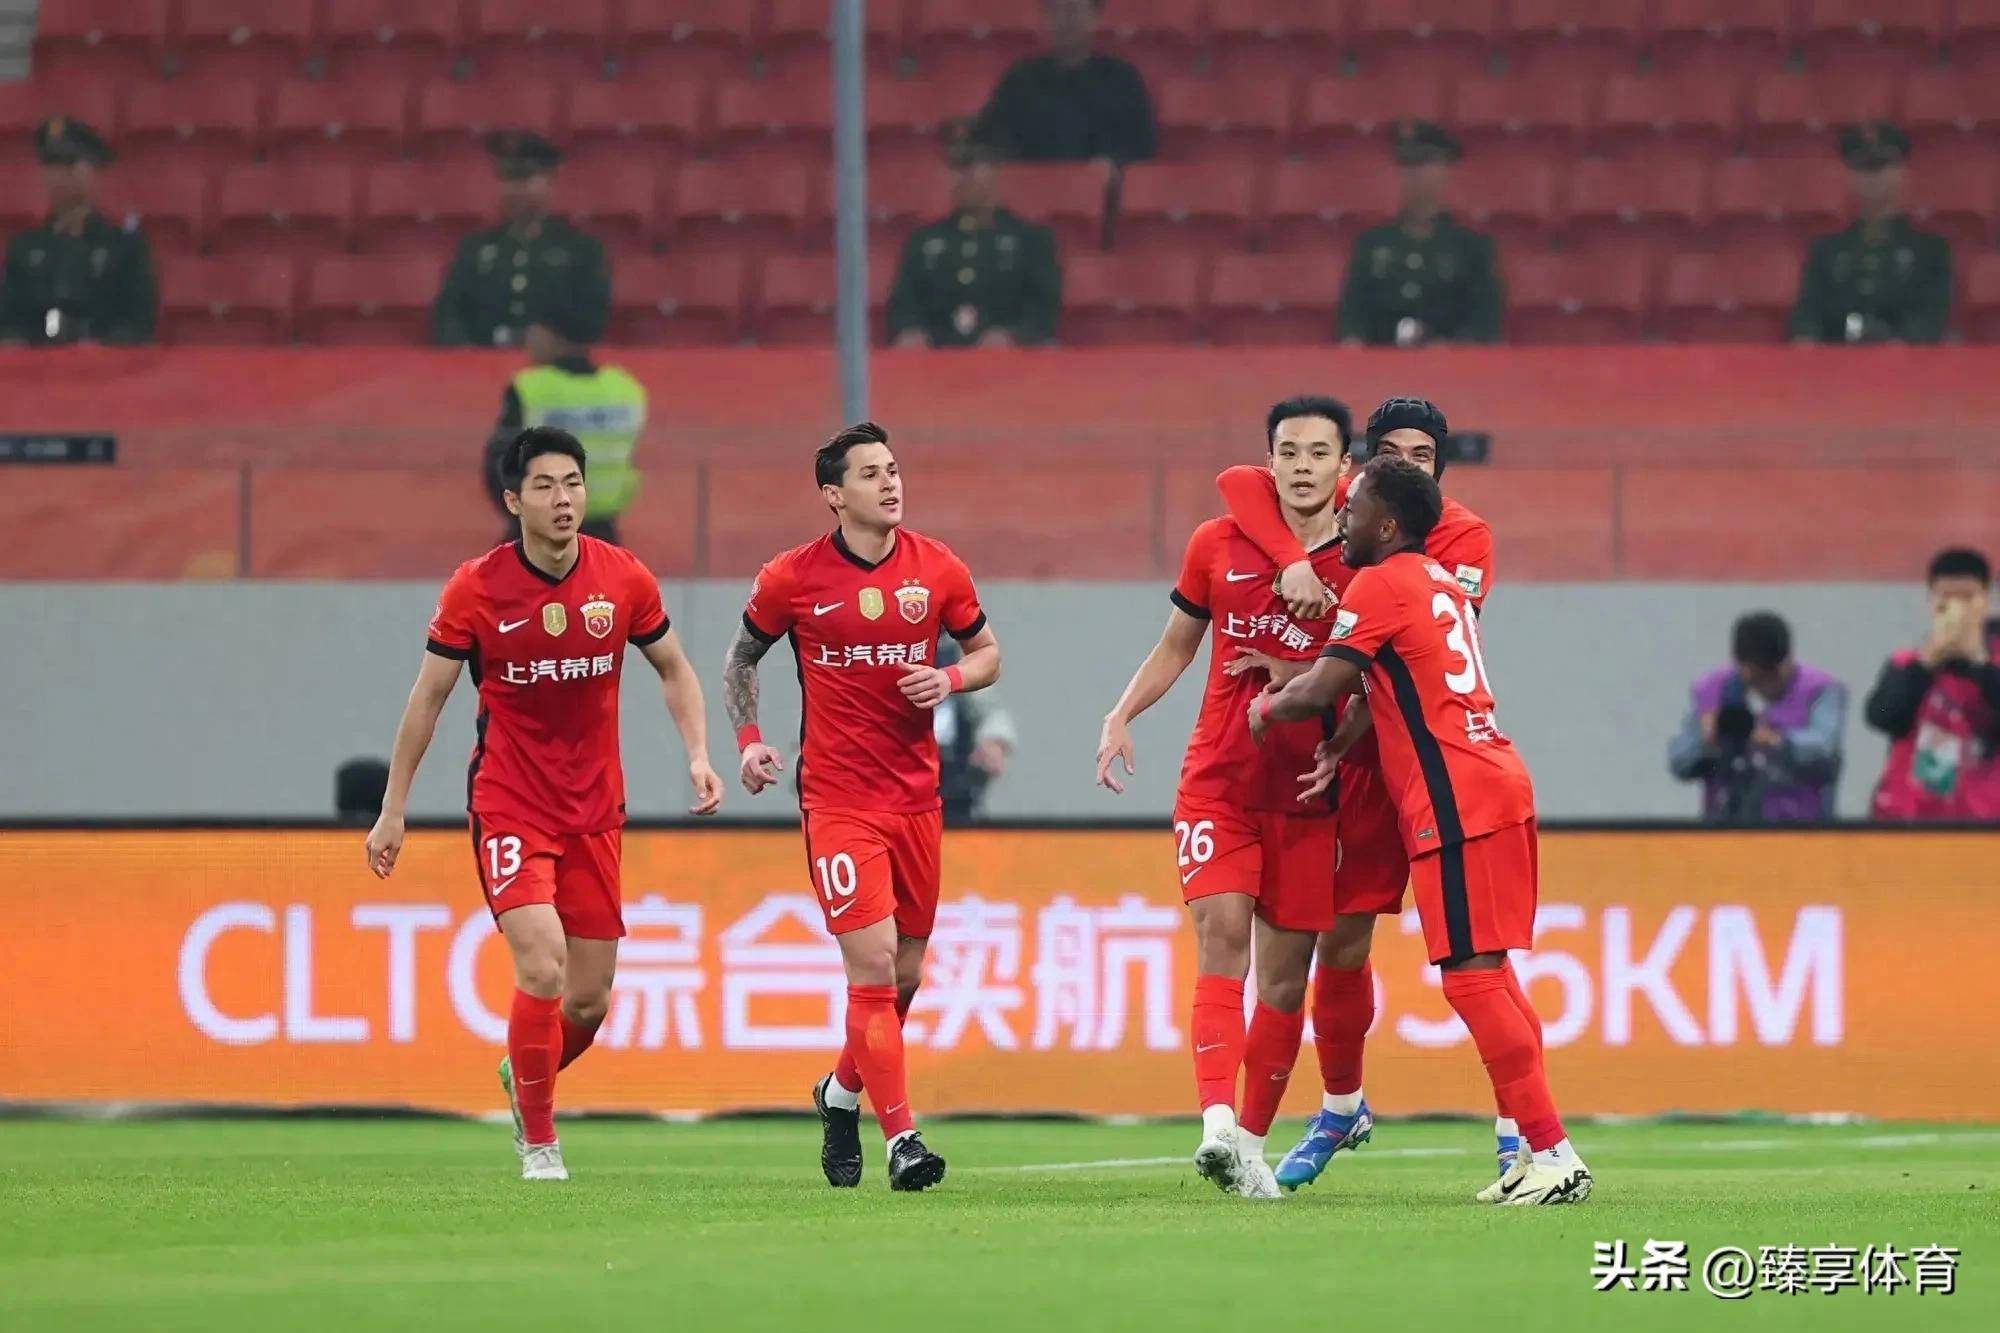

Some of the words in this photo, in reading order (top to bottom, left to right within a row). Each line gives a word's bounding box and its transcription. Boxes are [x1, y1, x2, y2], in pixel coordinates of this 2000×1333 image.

[500, 652, 614, 684] 上汽荣威
[812, 638, 932, 668] 上汽荣威
[486, 836, 523, 879] 13
[1174, 820, 1215, 867] 26
[815, 852, 858, 901] 10
